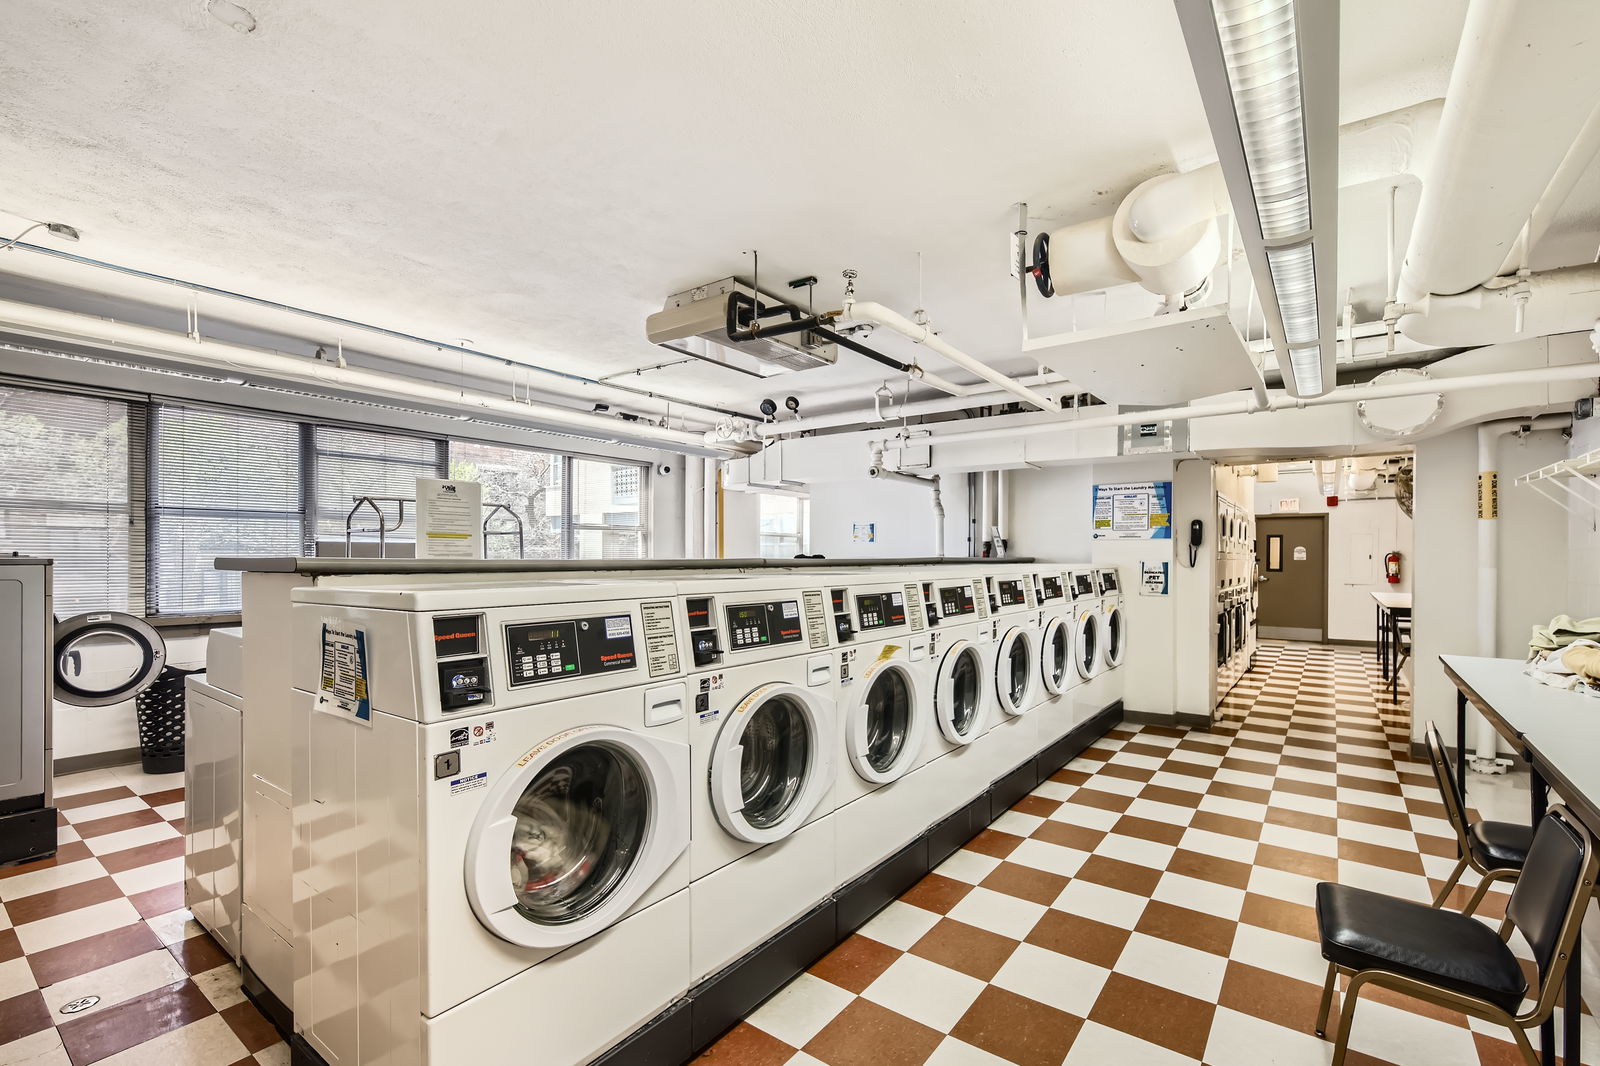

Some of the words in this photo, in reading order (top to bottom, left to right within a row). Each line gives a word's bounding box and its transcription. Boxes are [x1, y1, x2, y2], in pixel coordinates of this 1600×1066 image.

[434, 633, 455, 641] Speed
[600, 653, 617, 662] Speed
[700, 699, 705, 707] 2
[517, 744, 547, 767] LEAVE
[444, 758, 452, 771] 1
[459, 774, 479, 784] NOTICE
